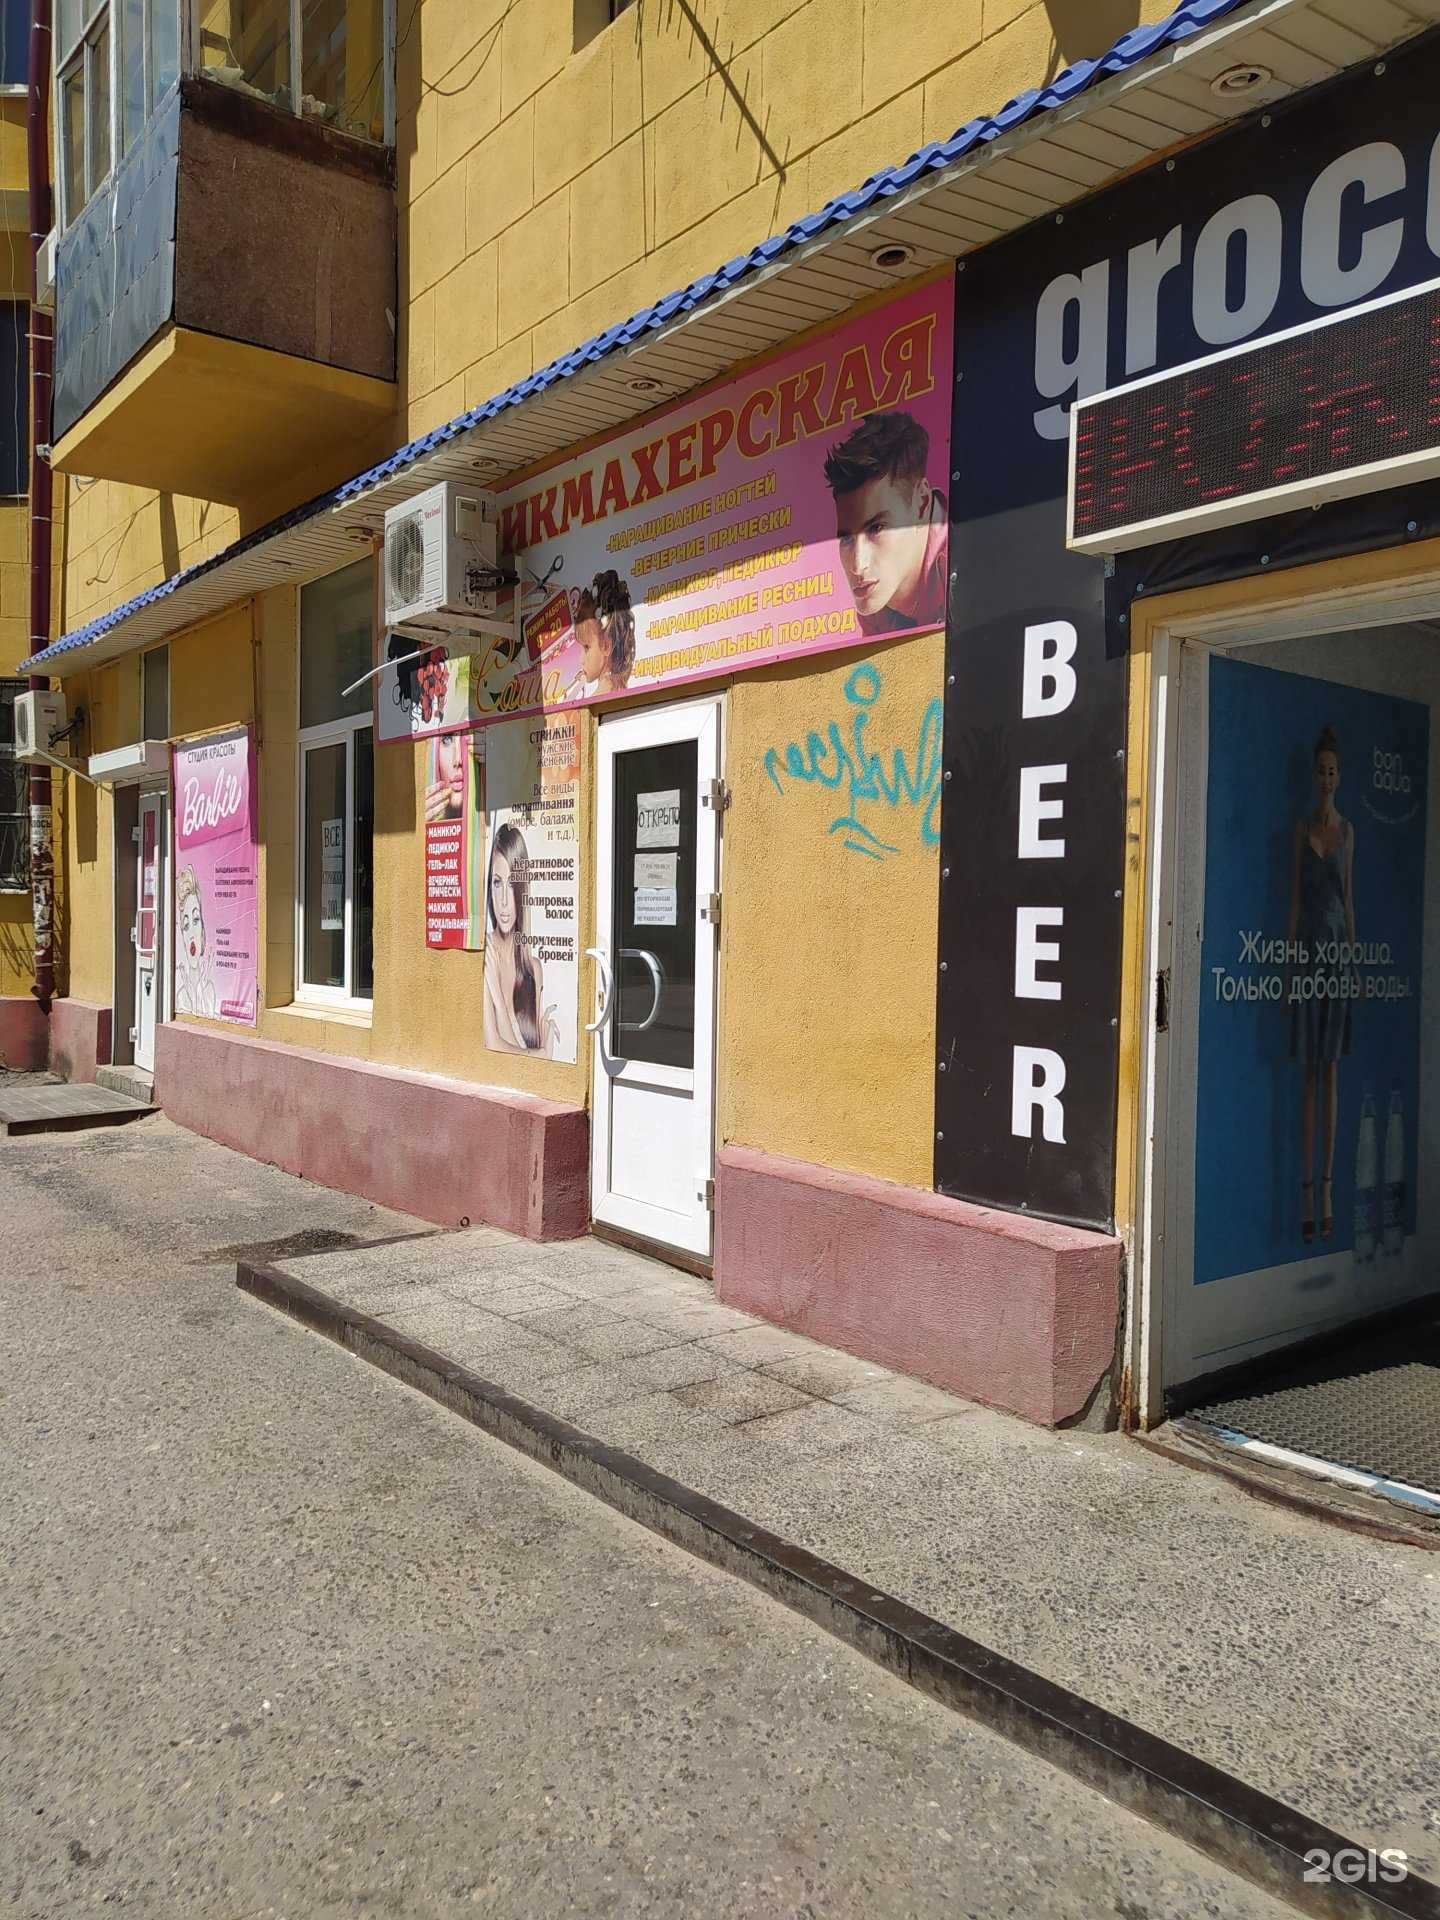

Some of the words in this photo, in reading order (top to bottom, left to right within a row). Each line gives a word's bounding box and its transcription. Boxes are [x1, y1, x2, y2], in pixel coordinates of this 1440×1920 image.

[497, 313, 937, 556] ИКМАХЕРСКАЯ
[714, 470, 777, 514] НОГТЕЙ
[708, 505, 792, 552] ПРИЧЕСКИ
[722, 539, 804, 586] ПЕДИКЮР
[761, 571, 835, 611] РЕСНИЦ
[777, 608, 857, 645] ПОДХОД
[529, 725, 575, 745] СТРИЖКИ
[187, 748, 208, 763] СТУДИЯ
[208, 743, 237, 760] КРАСОТЫ
[533, 783, 549, 796] Все
[550, 782, 575, 795] виды
[183, 767, 242, 836] Barbie
[511, 798, 575, 815] окрашивания
[540, 812, 575, 826] балаяж
[638, 807, 681, 828] ОТКРЫТО
[324, 826, 341, 848] ВСЕ
[547, 831, 554, 841] и
[513, 857, 574, 872] Кератиновое
[428, 875, 459, 886] ВЕЧЕРНИЕ
[509, 870, 574, 884] выпрямление
[1011, 619, 1078, 1144] BEER
[428, 886, 462, 898] ПРИЧЕСКИ
[522, 895, 574, 909] Полировка
[545, 909, 574, 919] волос
[514, 933, 574, 948] Оформление
[1238, 930, 1310, 964] Жизнь
[1315, 941, 1394, 971] хороша.
[538, 946, 574, 963] бровей
[1211, 967, 1283, 1001] Только
[1288, 967, 1361, 1005] добавь
[1365, 975, 1413, 1002] воды.
